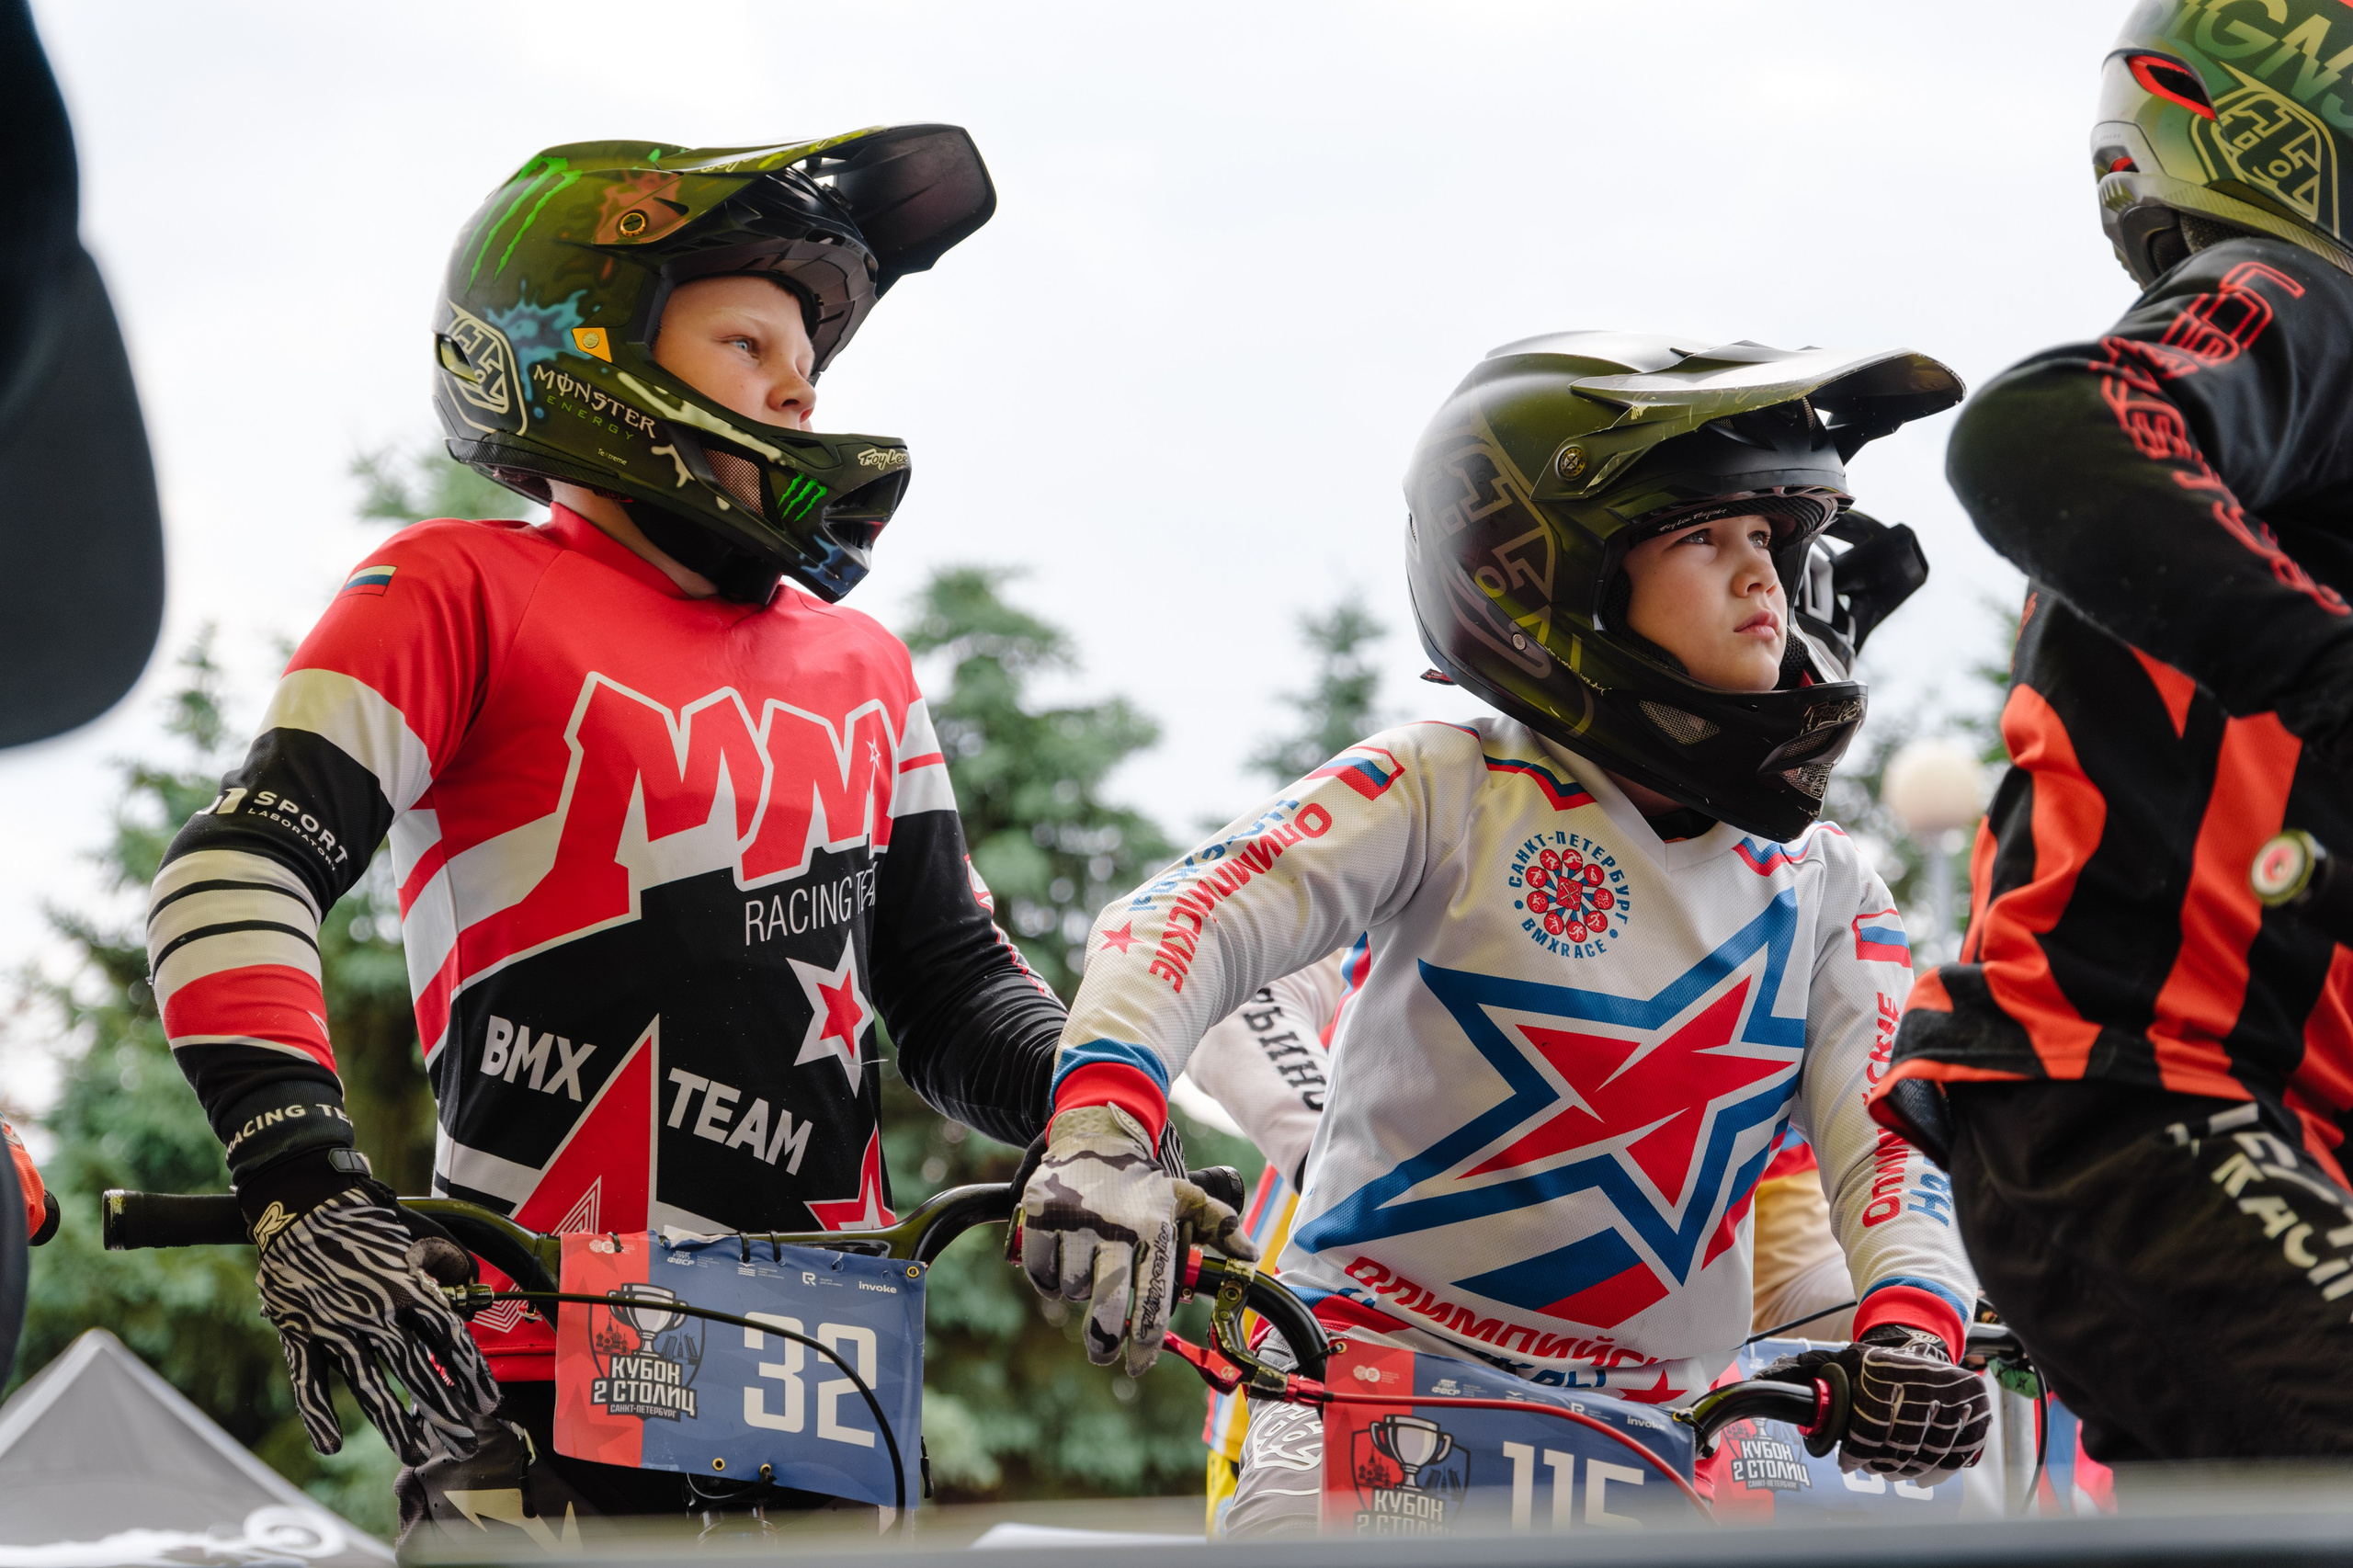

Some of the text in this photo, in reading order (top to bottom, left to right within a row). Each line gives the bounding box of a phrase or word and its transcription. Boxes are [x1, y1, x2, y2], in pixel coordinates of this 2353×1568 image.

[546, 394, 635, 440] ENERGY
[247, 807, 336, 871] LABORATORY
[253, 790, 348, 865] SPORT
[1508, 830, 1631, 926] САНКТ-ПЕТЕРБУРГ
[745, 875, 853, 947] RACING
[480, 1015, 813, 1176] BMX TEAM
[858, 1280, 898, 1295] invoke
[610, 1356, 680, 1386] КУБОК
[744, 1312, 877, 1449] 32
[593, 1379, 696, 1416] 2 СТОЛИЦ
[609, 1403, 677, 1419] САНКТ-ПЕТЕРБУРГ
[1627, 1415, 1666, 1432] invoke
[1740, 1439, 1794, 1462] КУБОК
[1502, 1440, 1644, 1535] 115
[1733, 1460, 1745, 1481] 2
[1746, 1460, 1811, 1487] СТОЛИЦ
[1374, 1490, 1444, 1523] КУБОК
